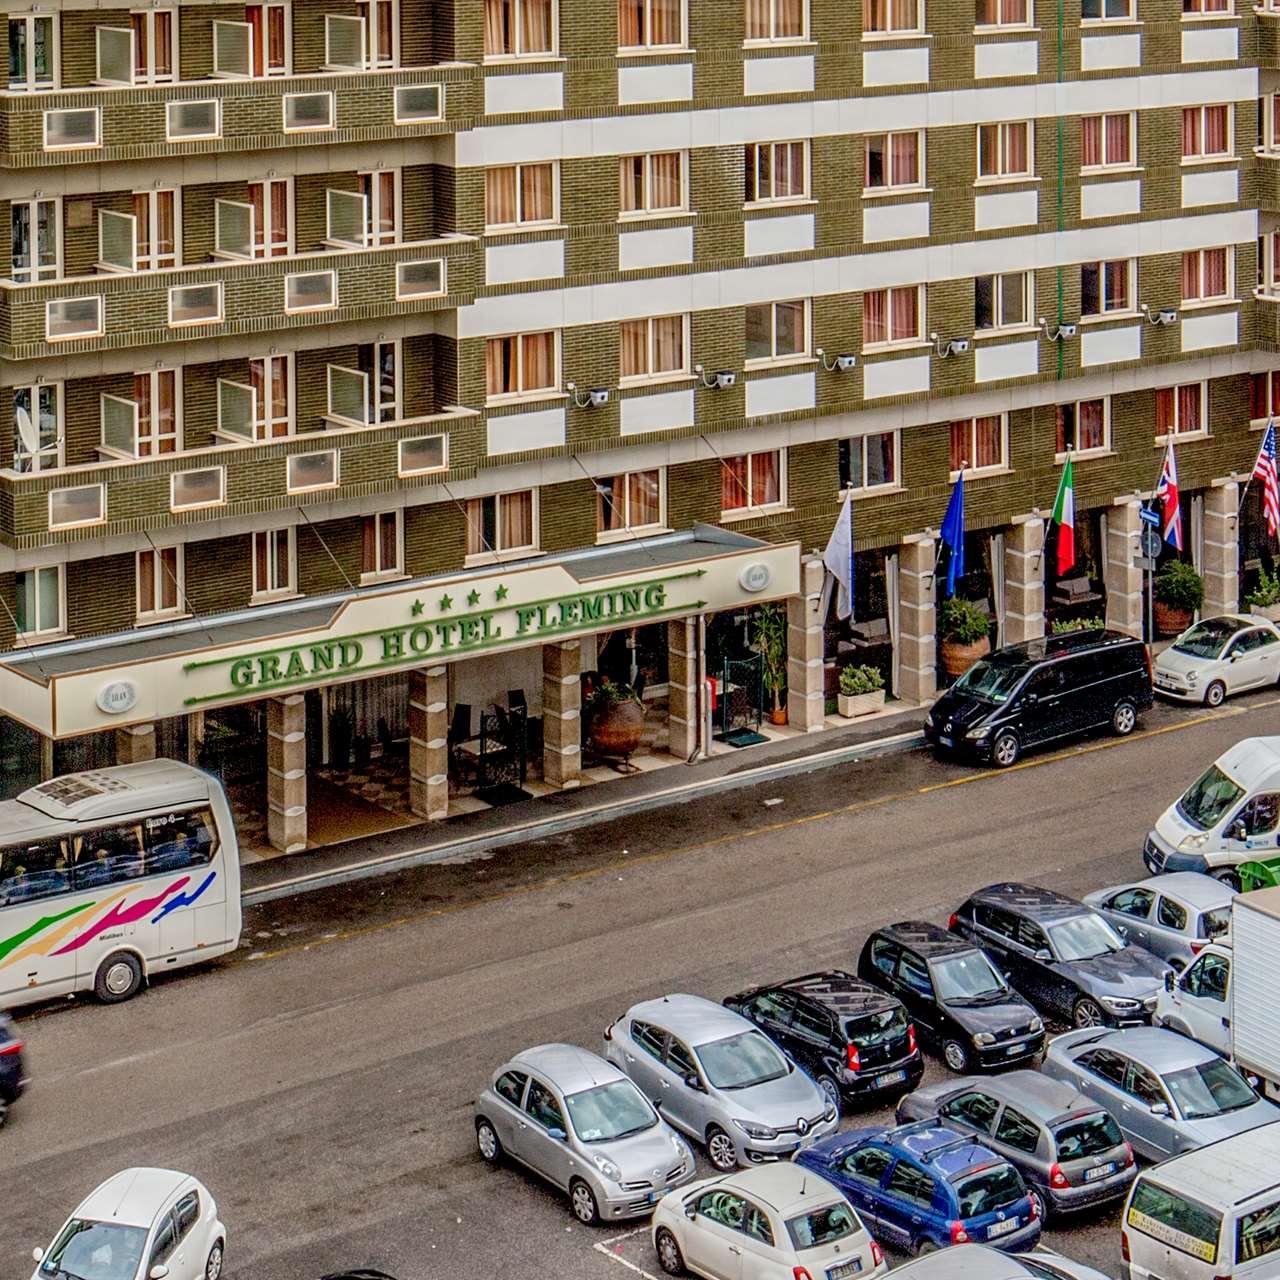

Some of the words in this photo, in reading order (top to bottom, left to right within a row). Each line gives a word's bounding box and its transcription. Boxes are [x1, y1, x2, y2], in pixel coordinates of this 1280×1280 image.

[230, 639, 363, 688] GRAND
[380, 613, 501, 661] HOTEL
[516, 583, 667, 634] FLEMING
